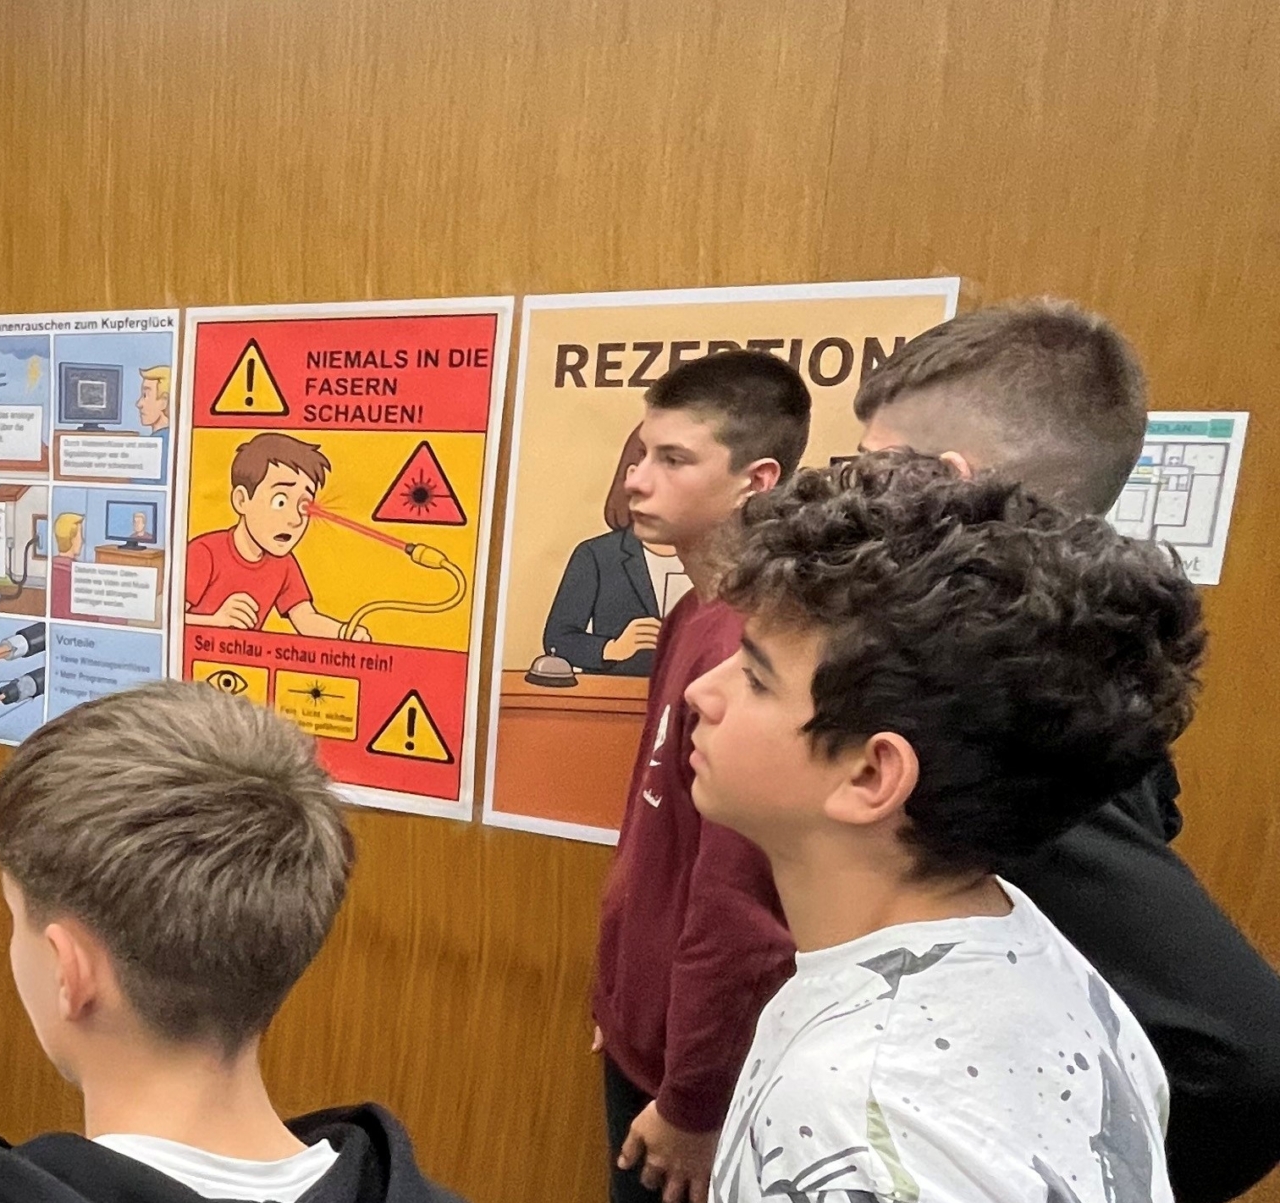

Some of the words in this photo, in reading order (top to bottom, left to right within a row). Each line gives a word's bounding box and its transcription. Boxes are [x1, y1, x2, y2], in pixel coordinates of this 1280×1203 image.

[74, 319, 98, 331] zum
[101, 317, 174, 332] Kupferglück
[307, 350, 408, 369] NIEMALS
[417, 349, 439, 368] IN
[448, 348, 489, 368] DIE
[305, 378, 398, 396] FASERN
[303, 405, 424, 424] SCHAUEN!
[56, 634, 95, 649] Vorteile
[194, 635, 215, 652] Sei
[220, 639, 262, 657] schlau
[275, 646, 316, 663] schau
[320, 651, 356, 669] nicht
[360, 655, 394, 672] rein!
